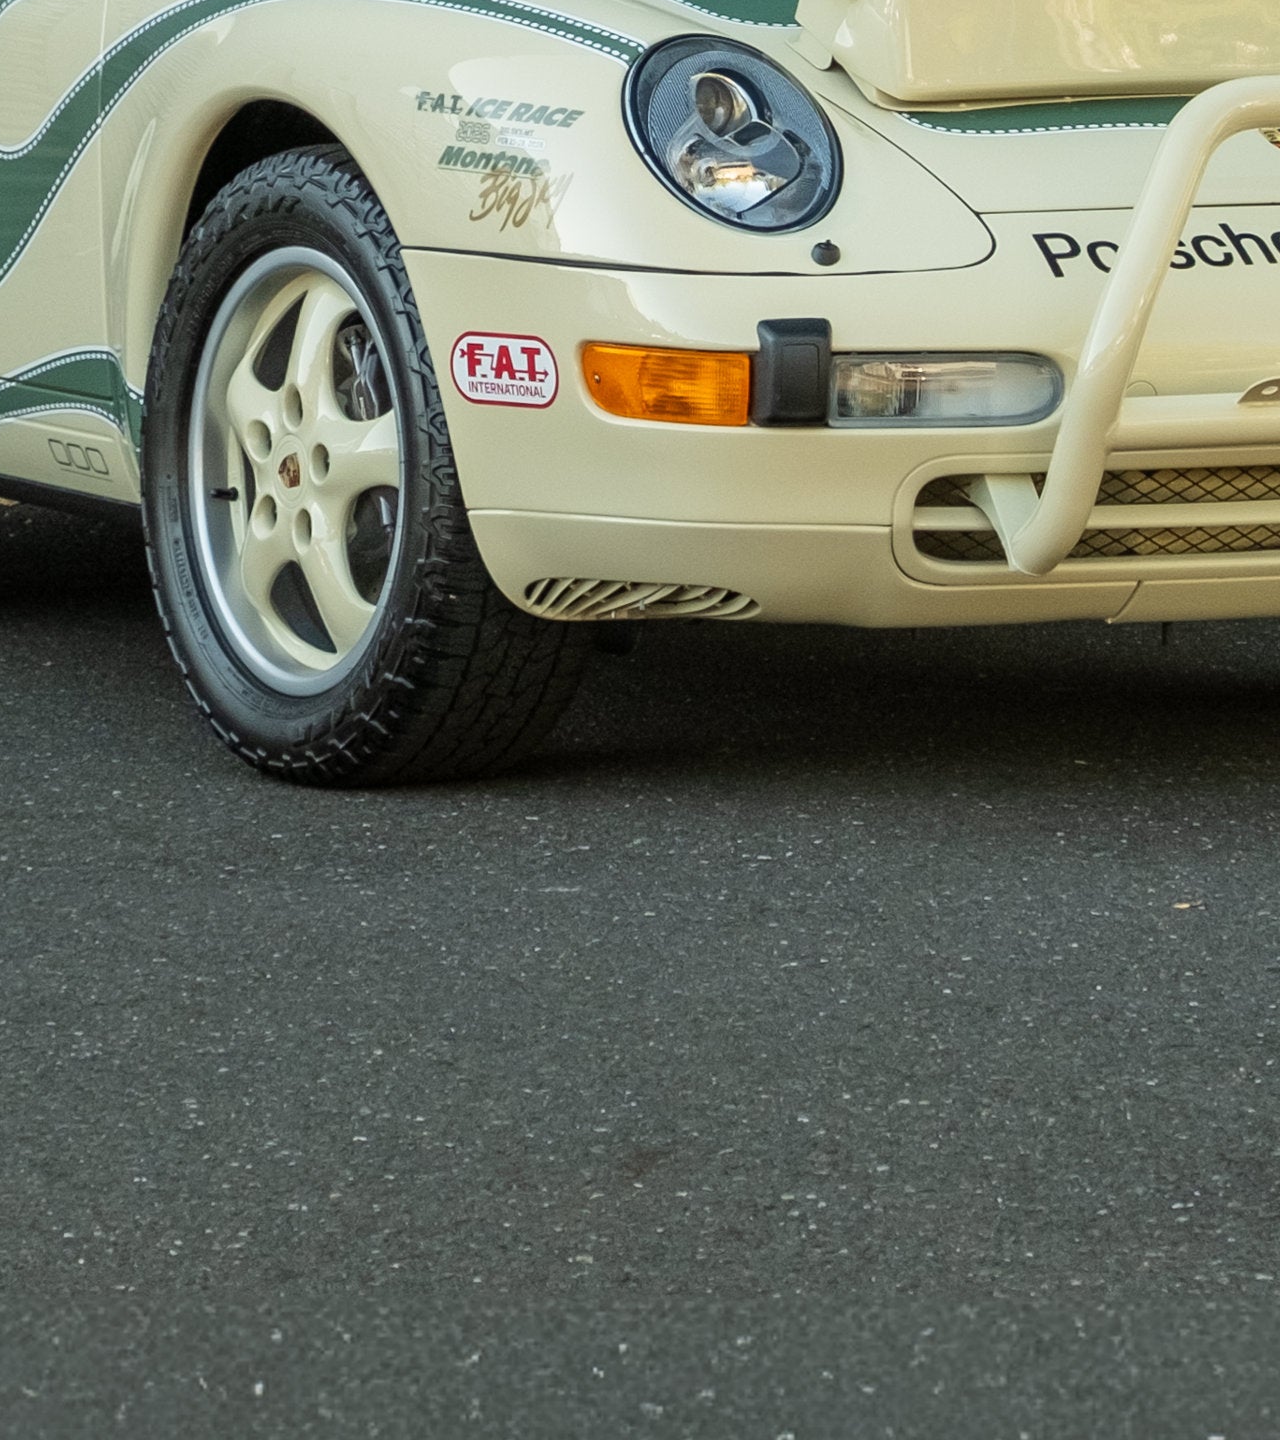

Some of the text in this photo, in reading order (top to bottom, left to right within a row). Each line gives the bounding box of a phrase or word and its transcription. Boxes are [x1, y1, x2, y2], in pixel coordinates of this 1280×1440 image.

[466, 97, 513, 120] ICE
[507, 101, 585, 128] RACE
[437, 145, 551, 177] Montana
[468, 381, 546, 399] INTERNATIONAL
